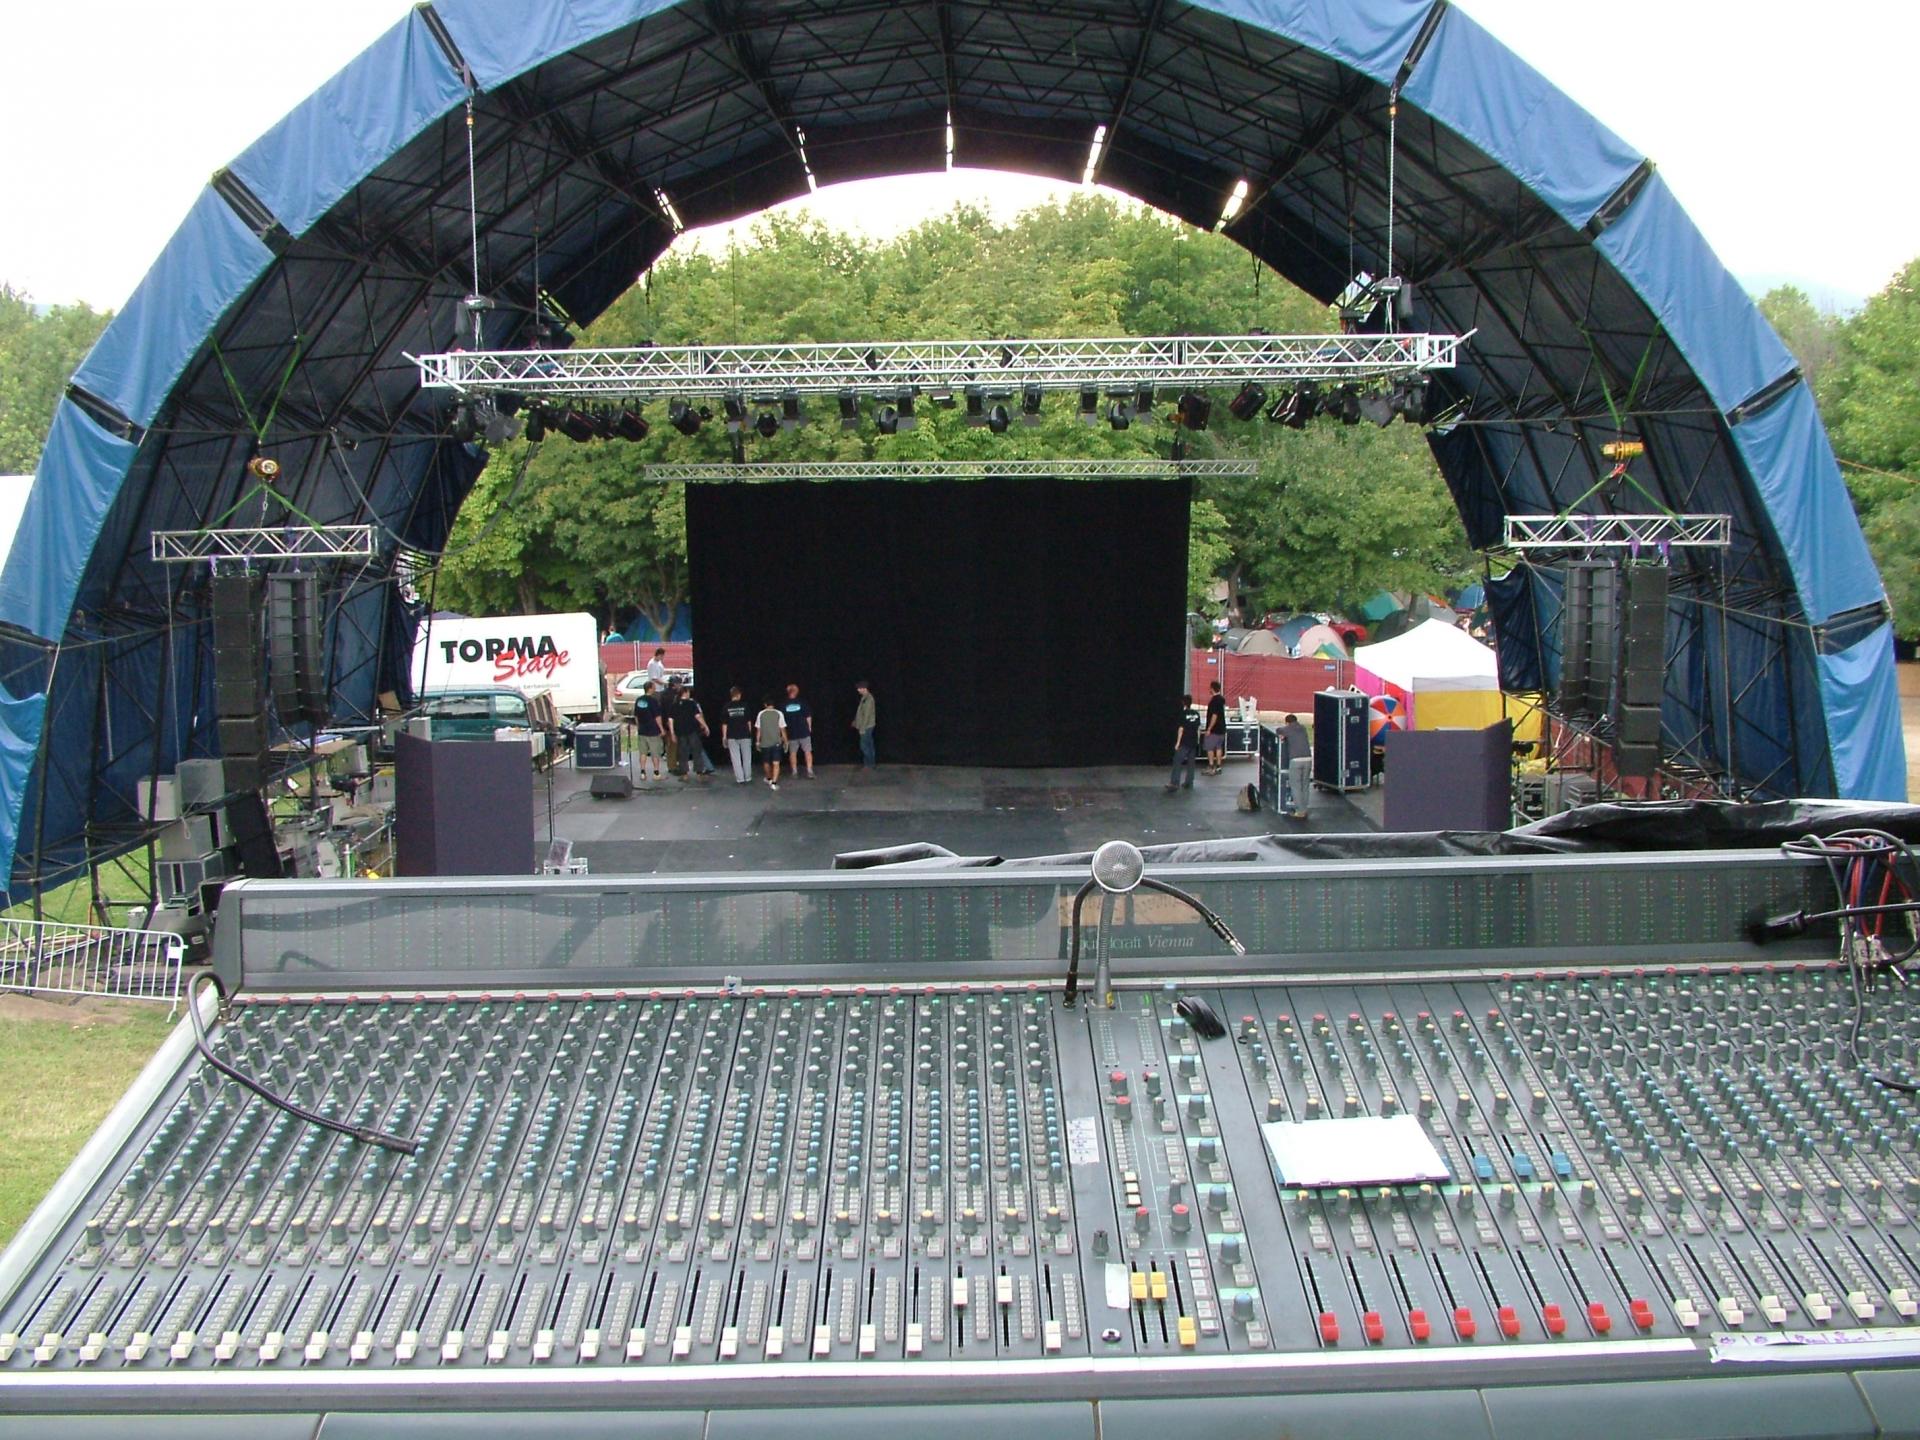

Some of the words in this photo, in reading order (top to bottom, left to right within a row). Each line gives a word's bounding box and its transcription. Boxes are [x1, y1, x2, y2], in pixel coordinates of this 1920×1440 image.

[440, 635, 558, 664] TORMA
[493, 649, 571, 683] Stage
[1147, 933, 1194, 948] Vienna
